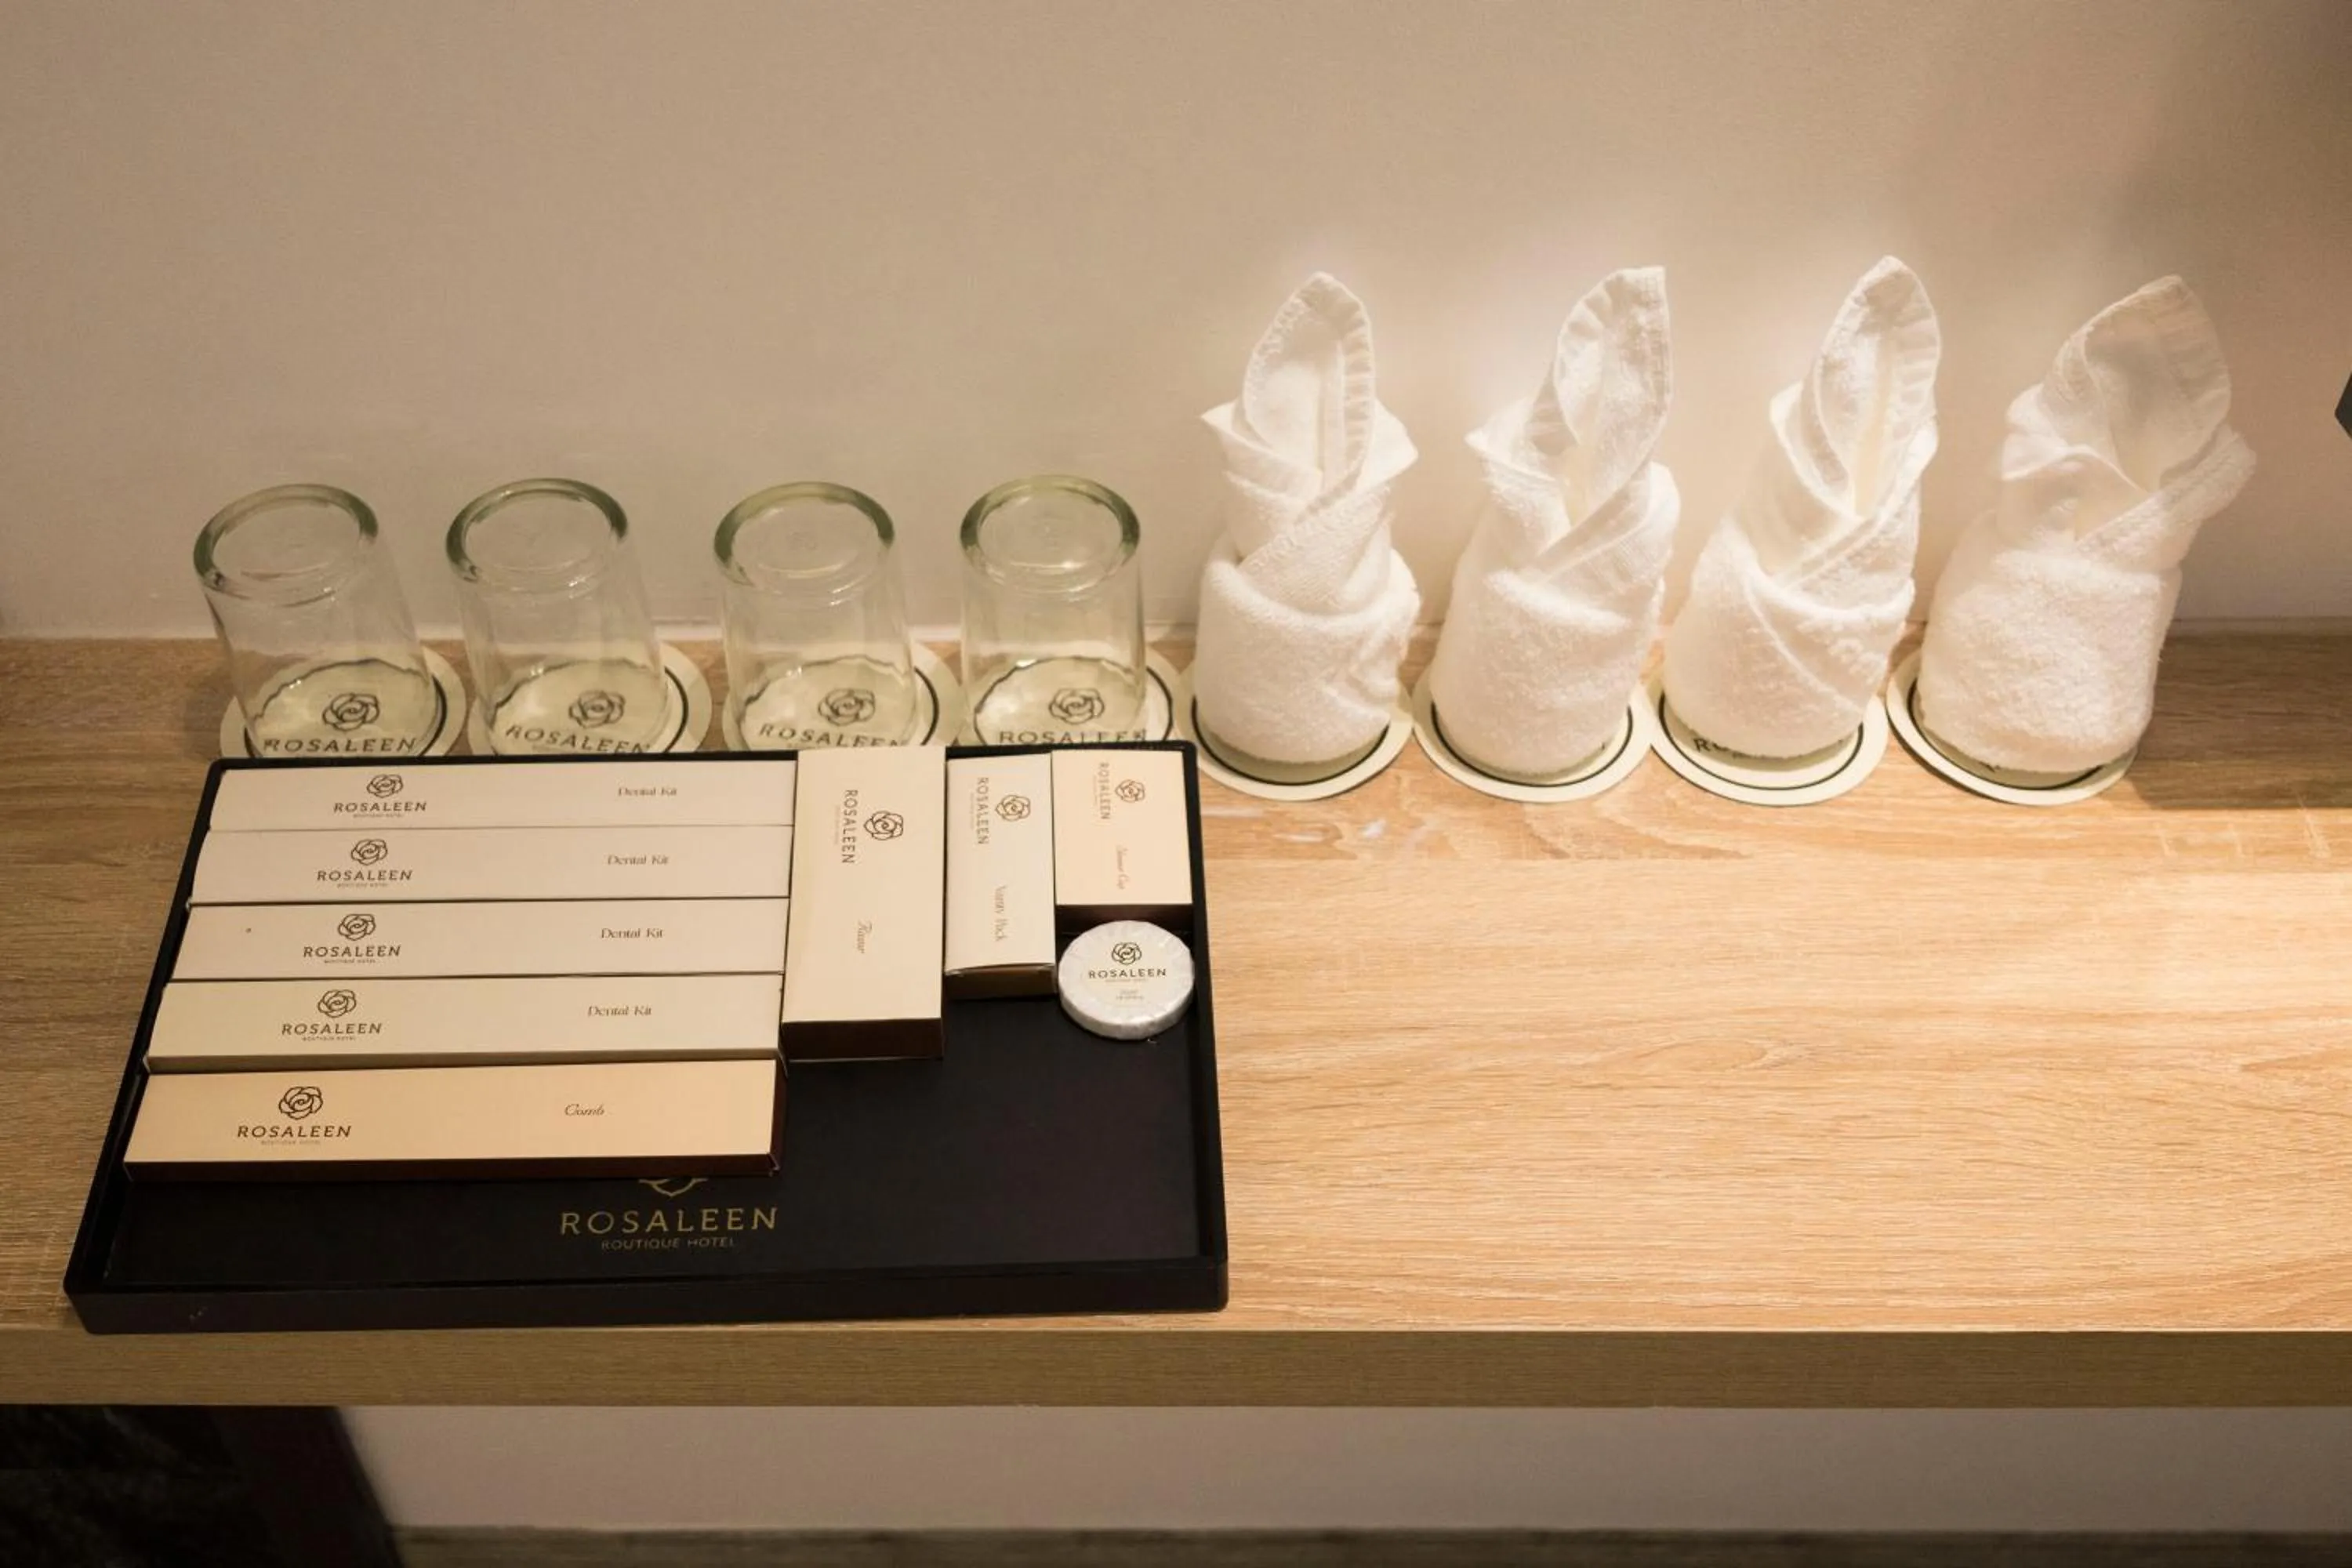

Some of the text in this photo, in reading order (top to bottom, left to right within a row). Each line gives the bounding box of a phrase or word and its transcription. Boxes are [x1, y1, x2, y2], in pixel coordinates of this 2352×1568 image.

[263, 737, 417, 753] ROSALEEN
[333, 800, 427, 813] ROSALEEN
[976, 777, 989, 845] ROSALEEN
[841, 789, 858, 864] ROSALEEN
[607, 855, 647, 865] Dental
[317, 869, 413, 882] ROSALEEN
[601, 927, 664, 939] Dental Kit
[303, 944, 402, 957] ROSALEEN
[1088, 968, 1167, 979] ROSALEEN
[587, 1005, 652, 1017] Dental Kit
[281, 1022, 383, 1036] ROSALEEN
[237, 1124, 352, 1138] ROSALEEN
[560, 1207, 779, 1236] ROSALEEN
[601, 1236, 735, 1251] BOUTIQUE HOTEL
